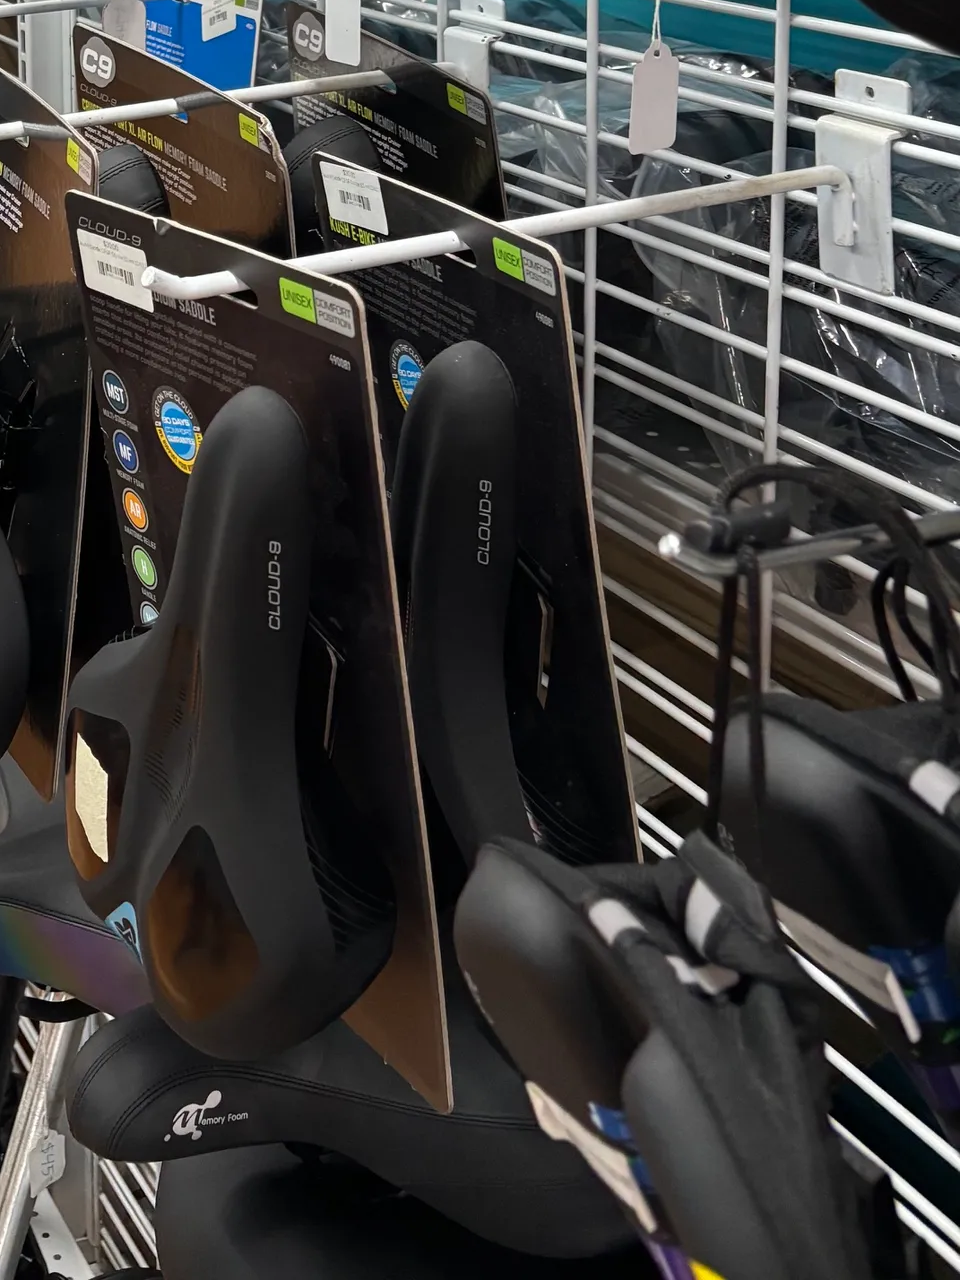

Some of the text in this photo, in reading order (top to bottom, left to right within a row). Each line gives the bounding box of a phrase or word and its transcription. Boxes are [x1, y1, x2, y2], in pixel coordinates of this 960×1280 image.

[295, 23, 323, 52] C9
[82, 48, 113, 79] C9
[80, 84, 117, 106] CLOUD-9
[398, 126, 415, 146] FOAM
[415, 135, 439, 159] SADDLE
[137, 128, 147, 141] AIR
[147, 132, 164, 151] FLOW
[164, 141, 187, 166] MEMORY
[188, 155, 205, 176] FOAM
[205, 167, 228, 192] SADDLE
[78, 216, 141, 247] CLOUD-9
[352, 225, 376, 245] E-BIKE
[495, 248, 553, 277] UNISEX COMFORT
[525, 269, 553, 289] POSITION
[178, 299, 217, 326] SADDLE
[281, 287, 351, 317] UNISEX COMFORT
[318, 311, 352, 331] POSITION
[106, 380, 124, 404] MST
[162, 390, 173, 399] THE
[174, 394, 193, 420] CLOUD
[172, 418, 190, 426] DAYS
[119, 442, 132, 462] MF
[130, 499, 142, 520] AR
[477, 479, 492, 566] CLOUD-9
[141, 559, 148, 576] H
[267, 540, 282, 631] CLOUD-9
[227, 1111, 249, 1122] Foam
